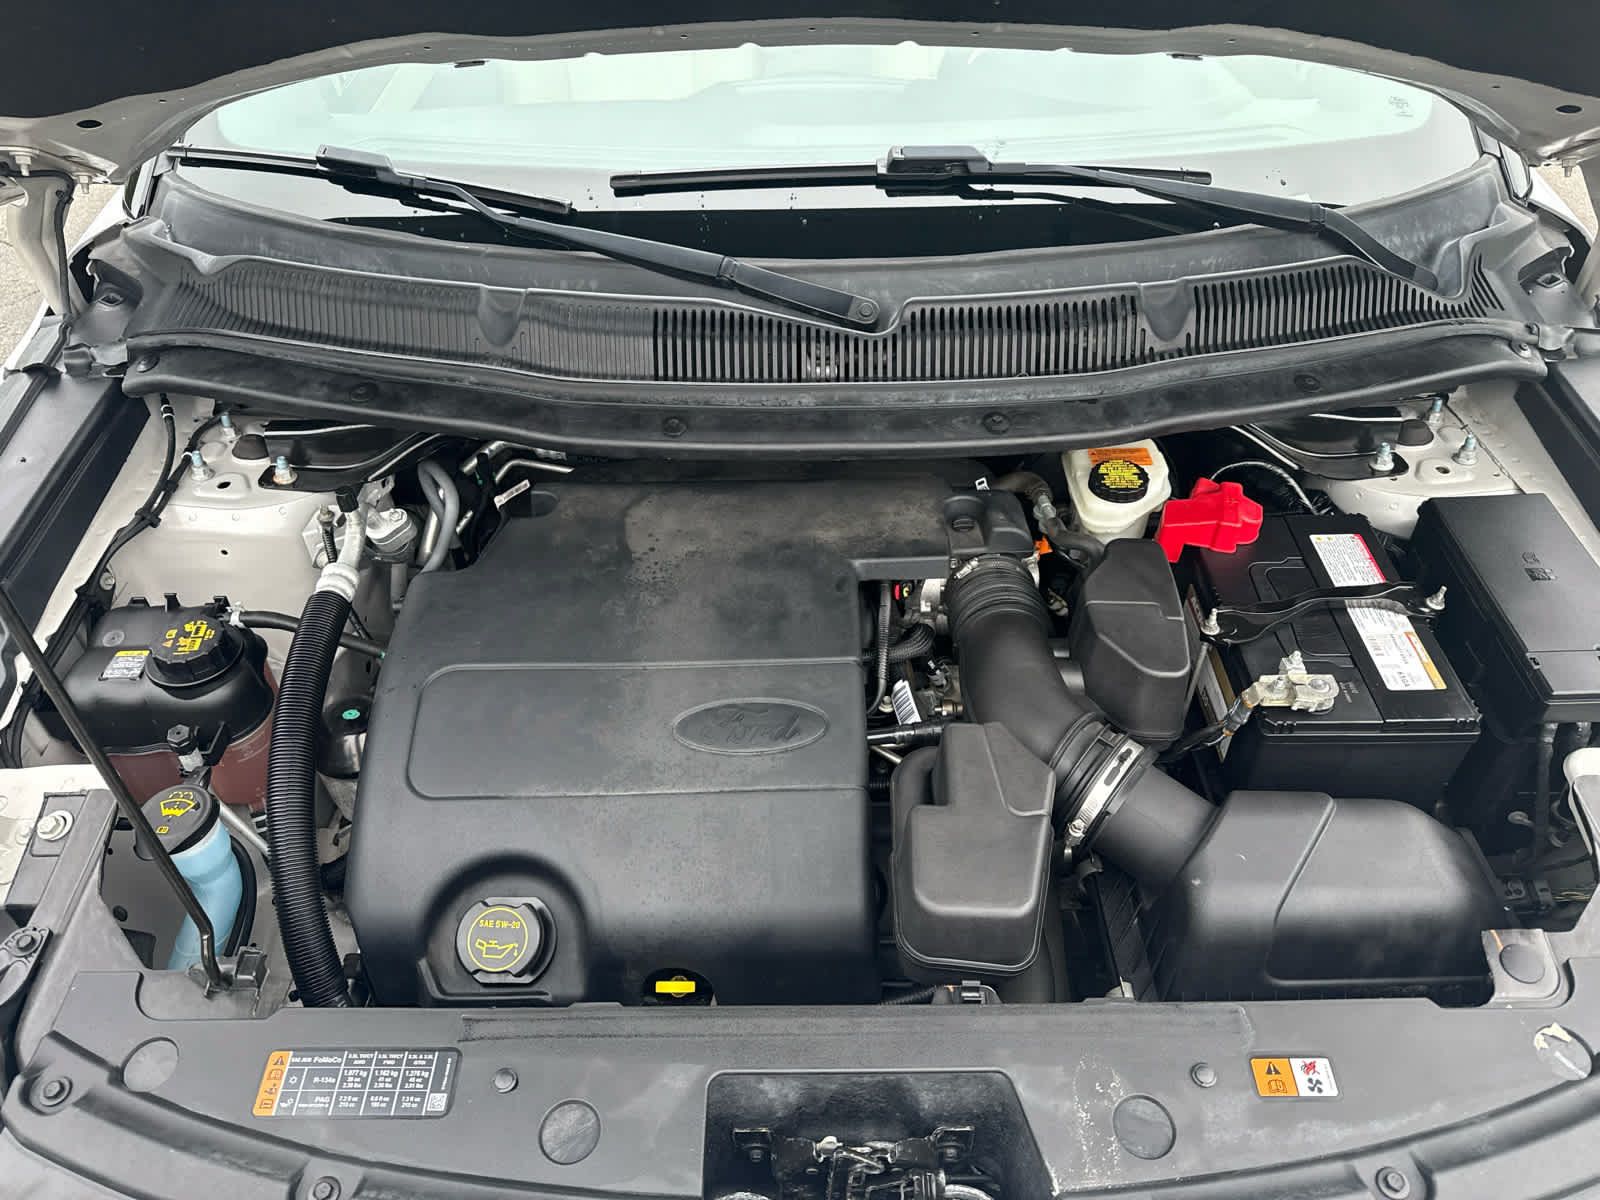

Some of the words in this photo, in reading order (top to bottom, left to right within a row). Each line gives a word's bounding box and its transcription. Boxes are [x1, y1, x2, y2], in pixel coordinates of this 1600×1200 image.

[700, 706, 801, 744] Ford
[479, 919, 494, 928] SAE
[496, 920, 521, 929] 5W-20
